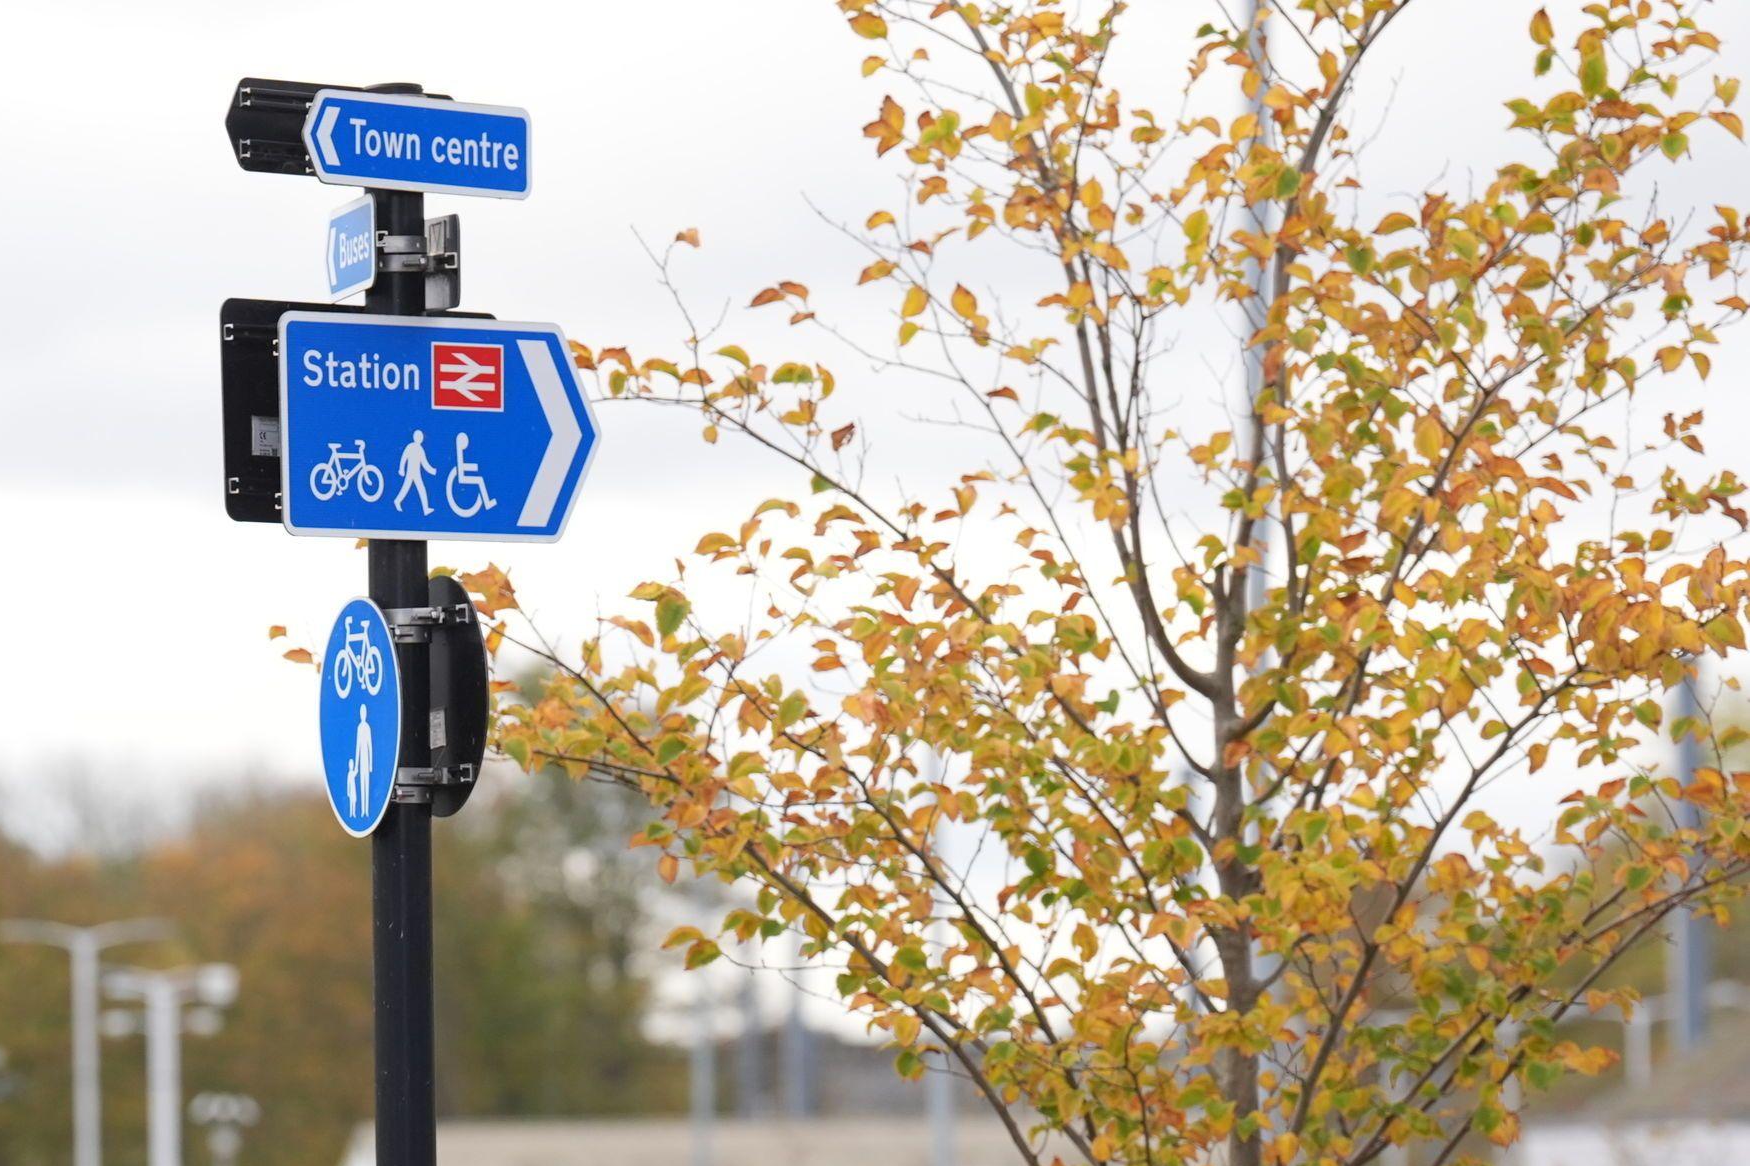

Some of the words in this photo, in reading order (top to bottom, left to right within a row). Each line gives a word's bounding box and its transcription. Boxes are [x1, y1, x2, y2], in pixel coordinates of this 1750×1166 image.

[349, 117, 421, 161] Town
[431, 131, 520, 171] centre
[338, 229, 370, 269] Buses
[302, 349, 420, 391] Station
